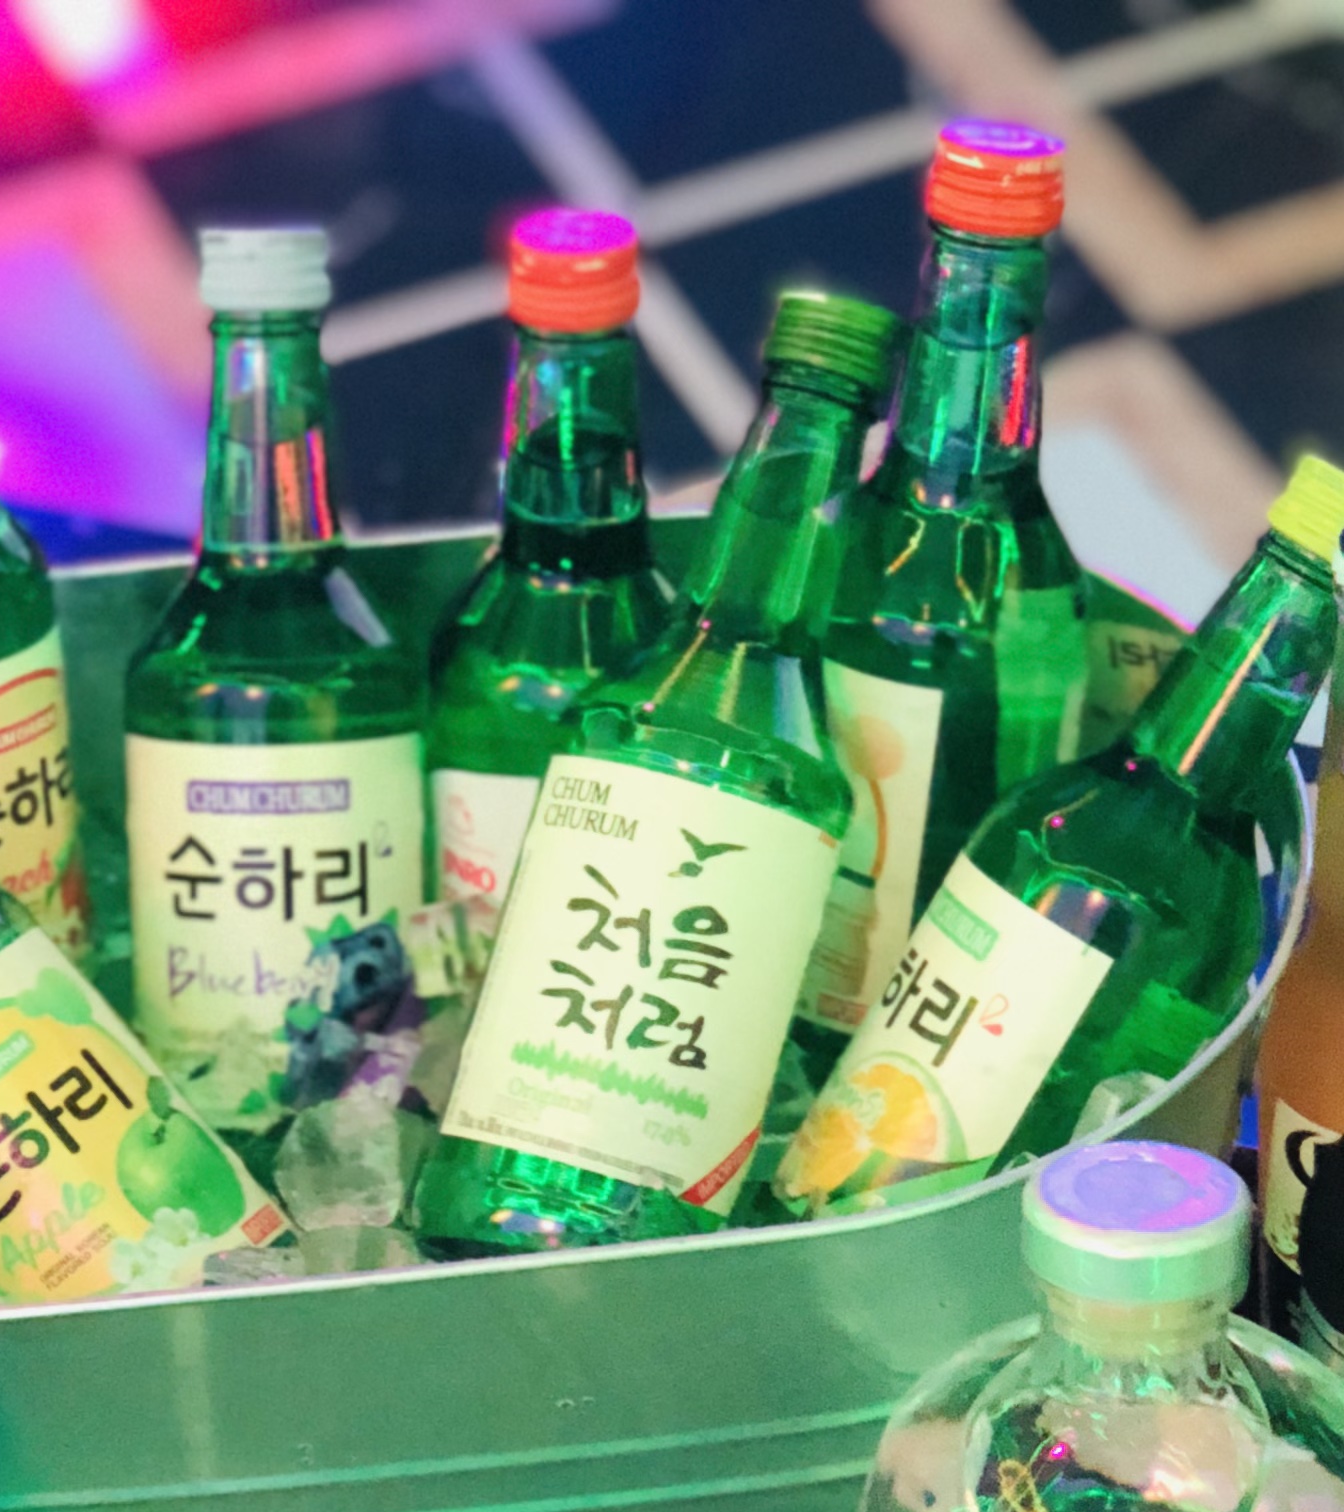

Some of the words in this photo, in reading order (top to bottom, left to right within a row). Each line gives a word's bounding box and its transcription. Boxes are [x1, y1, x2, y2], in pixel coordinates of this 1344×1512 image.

[190, 783, 253, 811] CHUM
[543, 803, 639, 841] CHURUM
[551, 776, 612, 806] CHUM
[164, 835, 370, 922] 순하리
[567, 864, 733, 990] 처음
[541, 960, 708, 1070] 처럼
